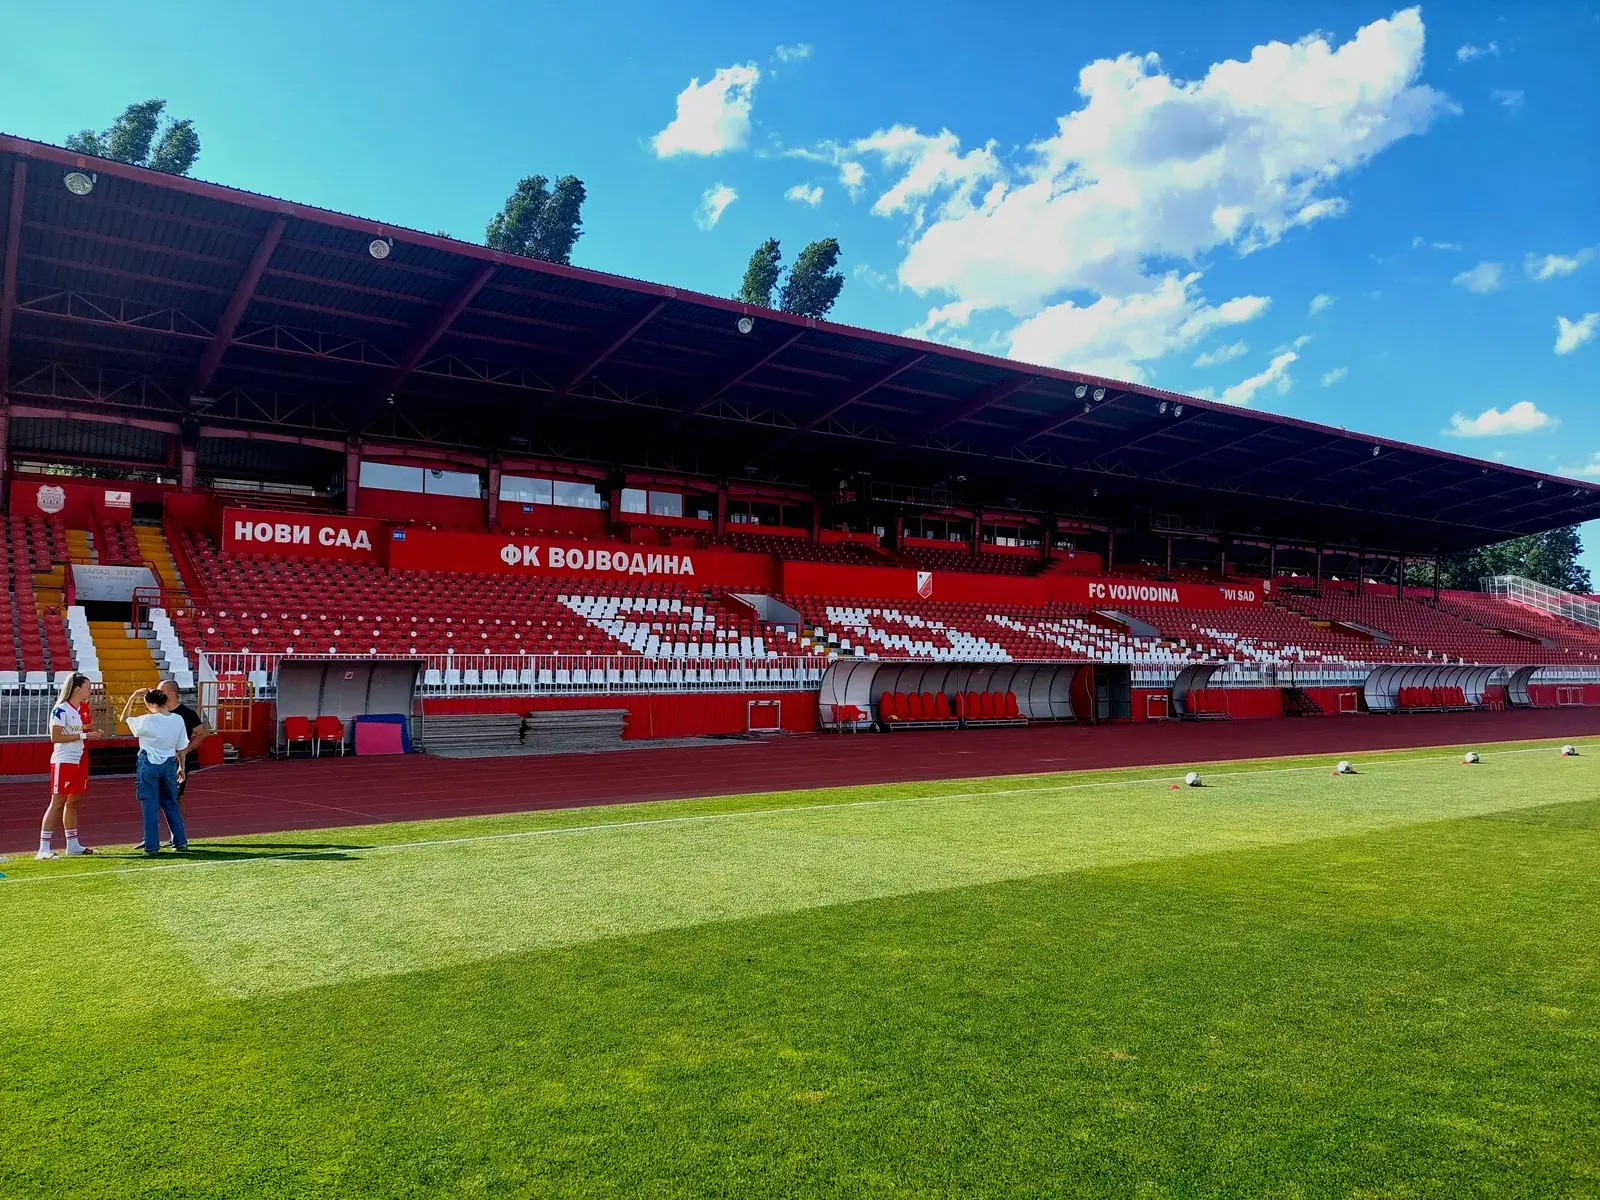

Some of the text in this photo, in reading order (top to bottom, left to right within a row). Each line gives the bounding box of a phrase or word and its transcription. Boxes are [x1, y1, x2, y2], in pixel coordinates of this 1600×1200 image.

[234, 520, 372, 551] НОВИ САД
[500, 543, 695, 576] ФК ВОЈВОДИНА
[81, 567, 110, 576] ЗАПАД
[1088, 583, 1180, 602] FC VOJVODINA
[1237, 589, 1255, 602] SAD
